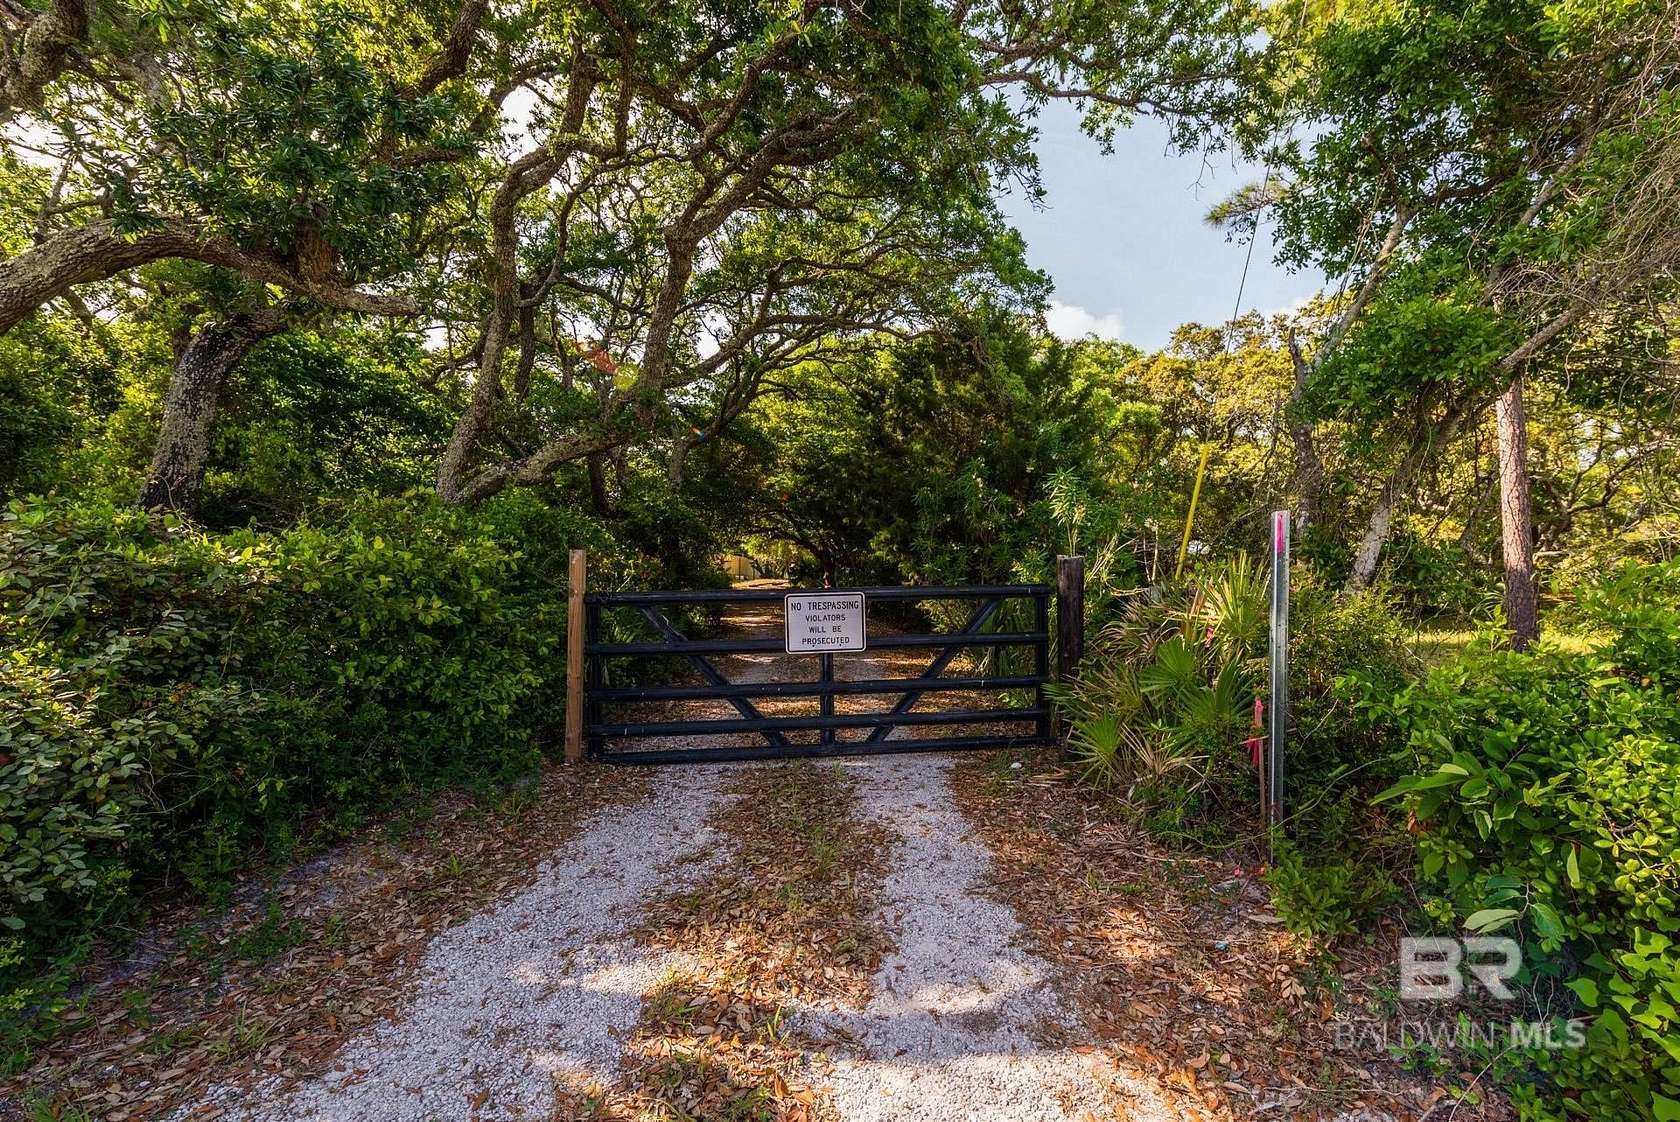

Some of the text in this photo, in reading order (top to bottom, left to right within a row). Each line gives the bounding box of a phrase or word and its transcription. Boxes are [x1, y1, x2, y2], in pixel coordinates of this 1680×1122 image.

[791, 601, 859, 611] NO TRESPASSING
[805, 614, 846, 622] VIOLATORS
[802, 637, 849, 645] PROSECUTED
